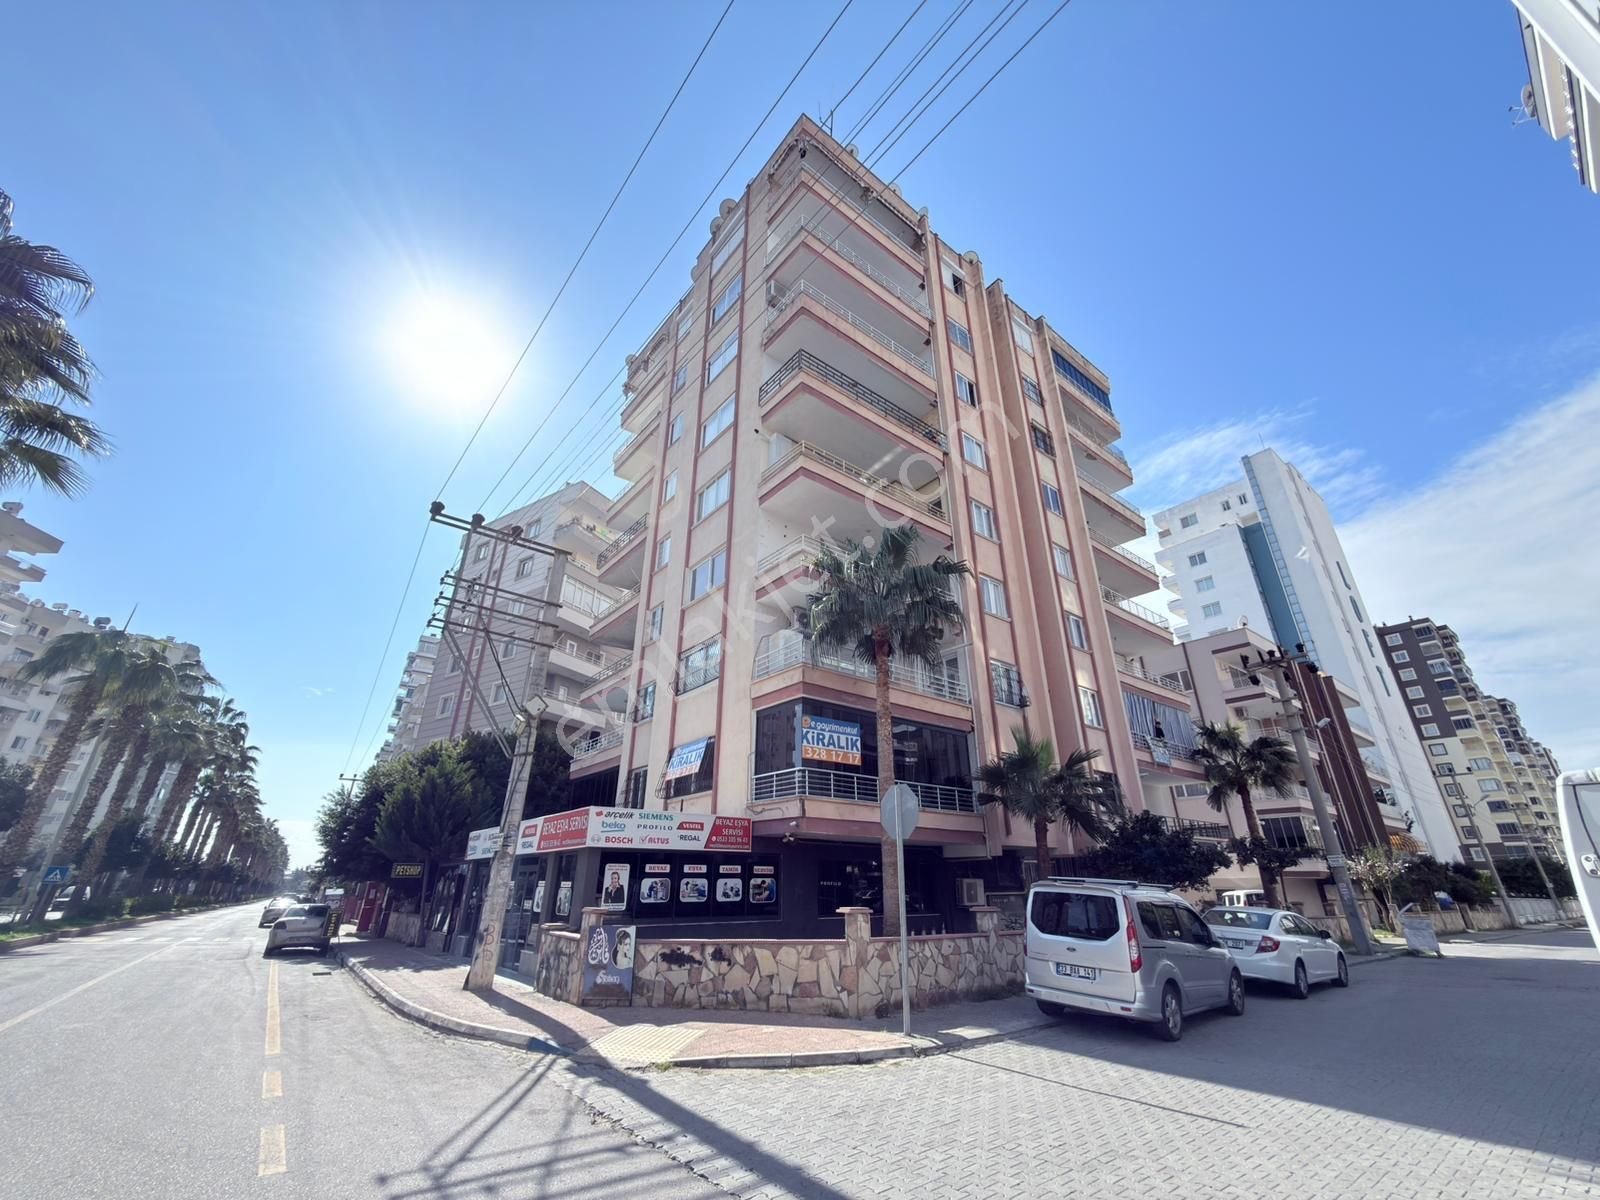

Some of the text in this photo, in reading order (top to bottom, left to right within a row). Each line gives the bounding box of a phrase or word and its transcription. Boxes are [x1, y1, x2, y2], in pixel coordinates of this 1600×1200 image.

[805, 747, 861, 764] 328 17 17
[604, 811, 673, 822] arçelik SIEMENS
[601, 821, 626, 829] beko
[715, 818, 733, 826] BEYAZ
[604, 834, 701, 845] BOSCH ALTUS REGAL
[395, 866, 421, 875] PETSHOP
